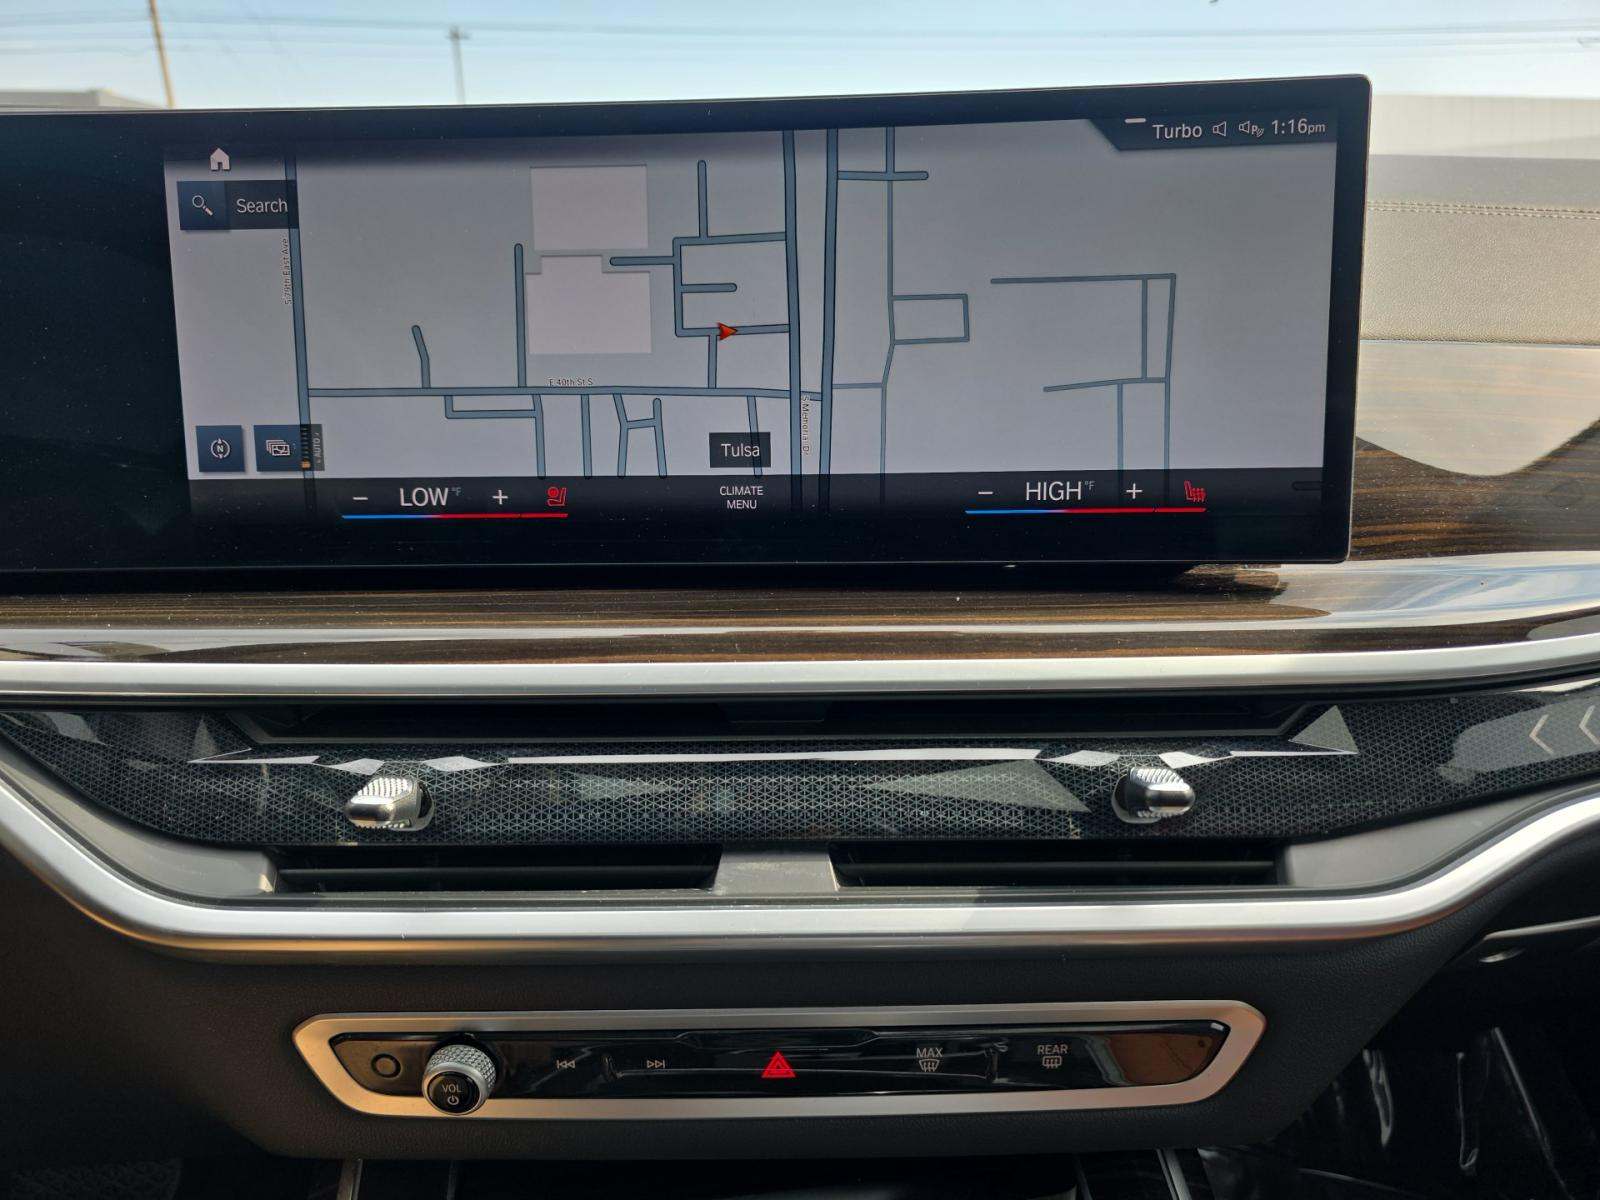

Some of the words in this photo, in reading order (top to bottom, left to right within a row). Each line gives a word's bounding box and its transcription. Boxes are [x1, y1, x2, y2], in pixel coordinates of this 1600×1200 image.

[1151, 123, 1203, 140] Turbo
[1271, 118, 1326, 135] 1:16pm
[236, 198, 289, 214] Search
[282, 256, 291, 276] East
[720, 443, 761, 458] Tulsa
[399, 487, 449, 507] LOW
[719, 485, 765, 496] CLIMATE
[1025, 481, 1082, 501] HIGH
[726, 499, 758, 510] MENU
[915, 1047, 944, 1059] MAX
[1036, 1043, 1069, 1056] REAR
[441, 1083, 463, 1093] VOL
